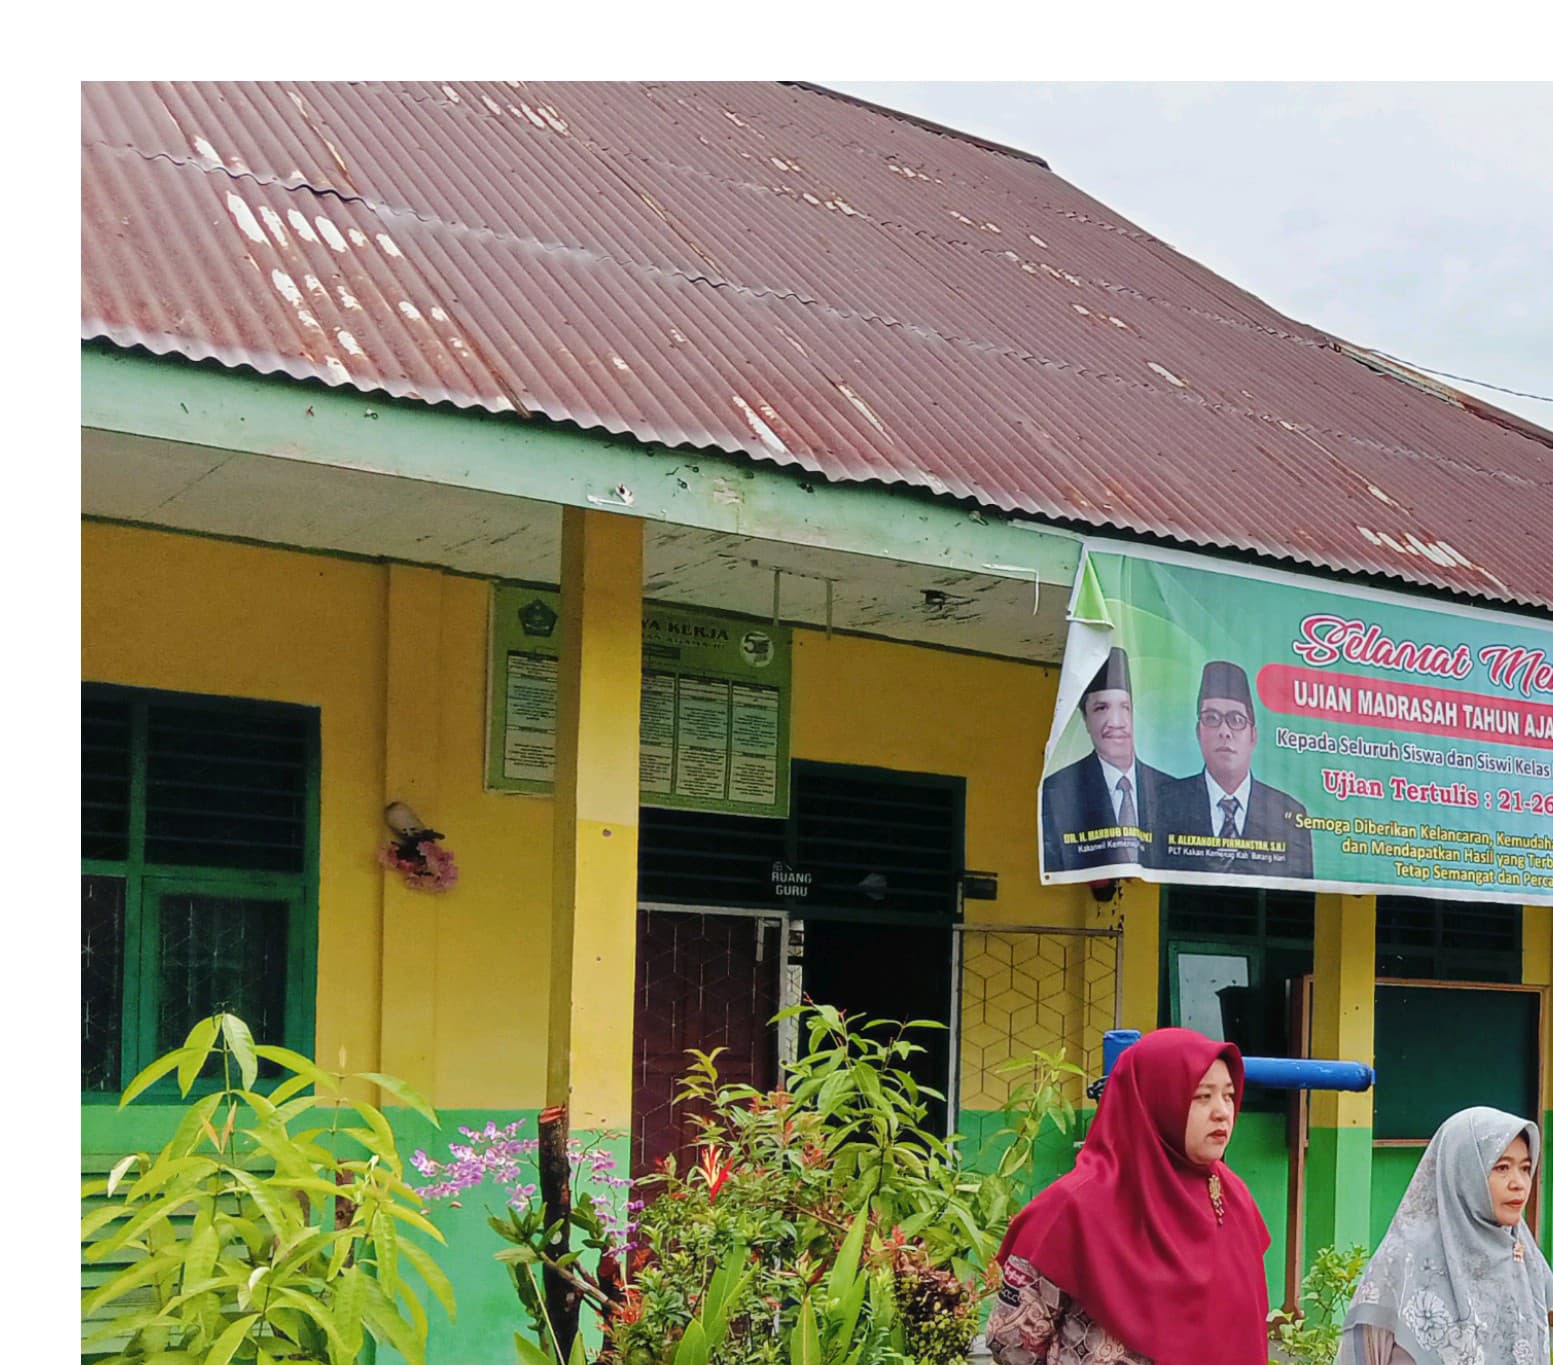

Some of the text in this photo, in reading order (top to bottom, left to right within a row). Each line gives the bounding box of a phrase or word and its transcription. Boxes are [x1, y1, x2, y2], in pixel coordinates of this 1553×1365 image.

[1294, 614, 1473, 679] Selamat
[1294, 680, 1352, 713] UJIAN
[1358, 689, 1457, 727] MADRASAH
[1462, 704, 1520, 736] TAHUN
[1277, 729, 1336, 754] Kepada
[1340, 735, 1399, 759] Seluruh
[1403, 745, 1443, 766] Siswa
[1447, 750, 1473, 769] dan
[1477, 754, 1511, 772] Siswi
[1515, 759, 1550, 778] Kelas
[1322, 769, 1383, 800] Ujian
[1389, 776, 1479, 808] Tertulis
[1484, 791, 1493, 809] :
[1295, 813, 1350, 835] Semoga
[1354, 818, 1416, 838] Diberikan
[1420, 825, 1494, 846] Kelancaran,
[1342, 838, 1368, 854] dan
[1371, 841, 1460, 862] Mendapatkan
[1463, 848, 1494, 864] Hasil
[1496, 854, 1526, 870] yang
[771, 871, 812, 884] RUANG
[1394, 861, 1429, 879] Tetap
[1432, 865, 1494, 886] Semangat
[1499, 870, 1520, 885] dan
[775, 884, 808, 897] GURU
